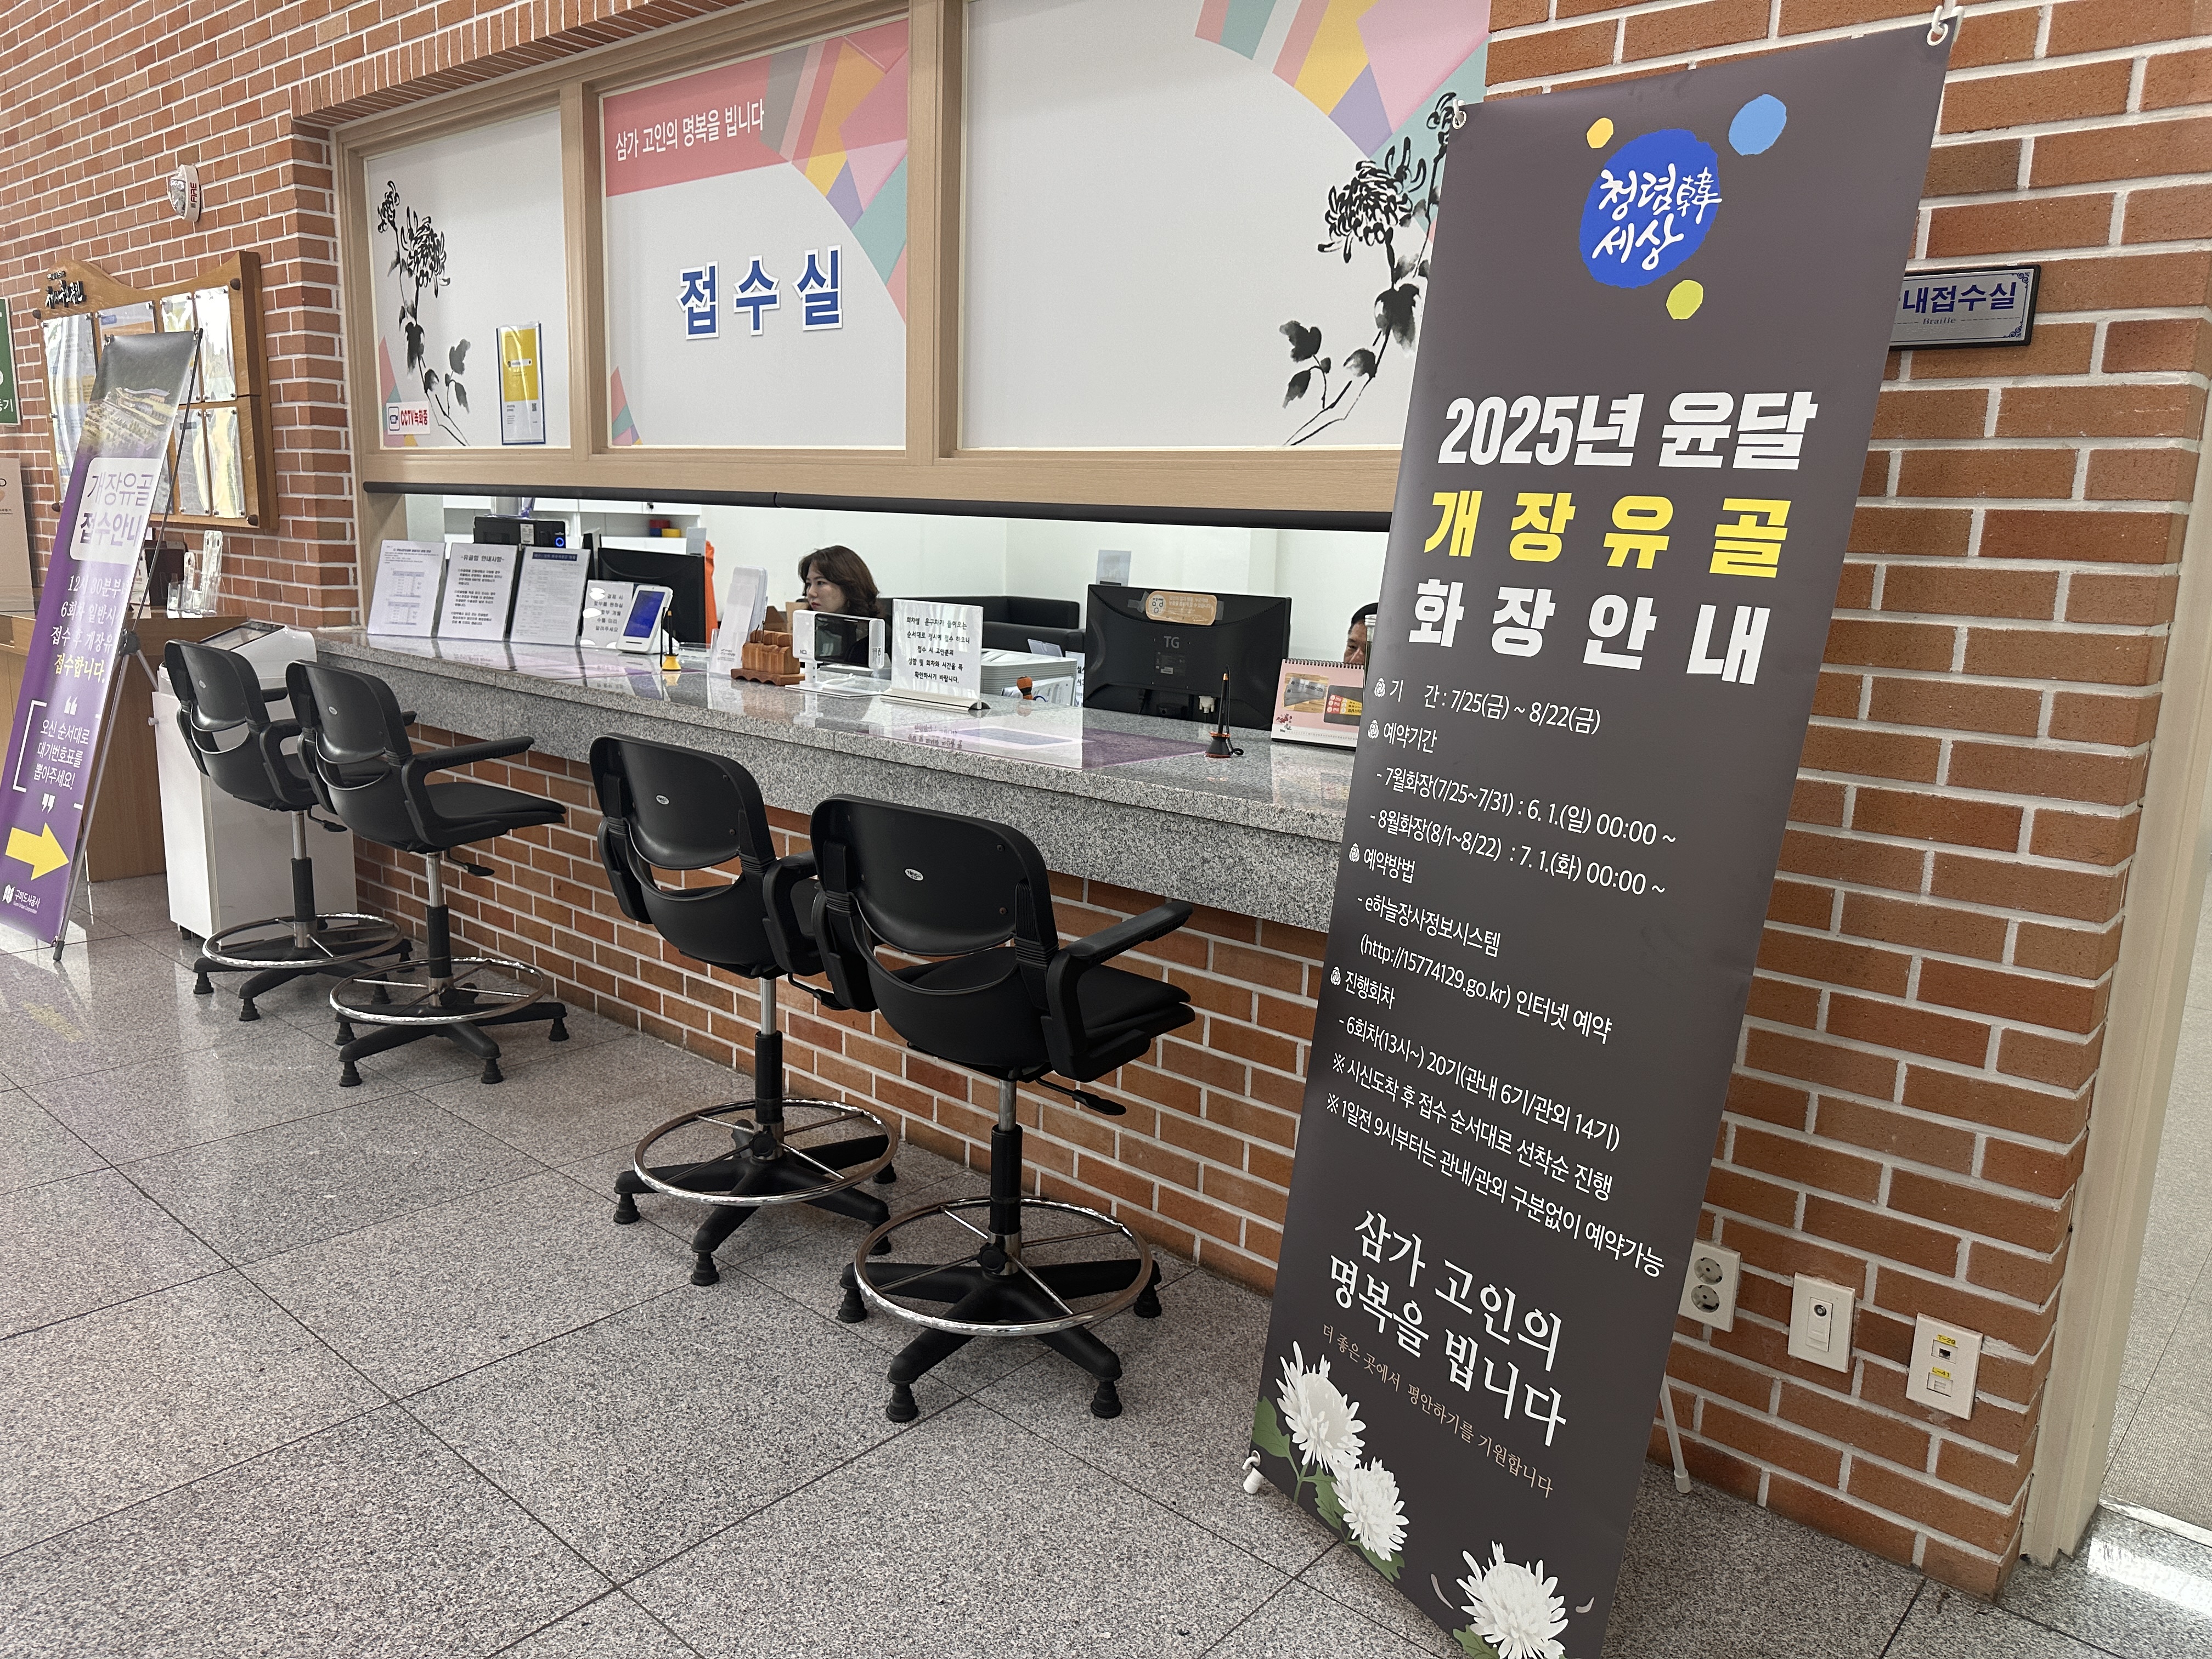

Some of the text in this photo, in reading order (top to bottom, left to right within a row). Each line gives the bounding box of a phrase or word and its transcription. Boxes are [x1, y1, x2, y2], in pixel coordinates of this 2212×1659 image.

[615, 98, 765, 161] 삼가 고인의 명복을 빕니다
[1592, 213, 1684, 270] 세상
[1899, 282, 2017, 313] 내접수실
[400, 409, 427, 426] CCTV녹화중
[1438, 392, 1818, 470] 2025년 윤달
[87, 472, 154, 506] 개장유골
[80, 512, 144, 546] 접수안내
[68, 575, 88, 595] 12시
[61, 601, 85, 622] 6회차
[906, 617, 967, 630] 회차별 운구차가 들어오는
[50, 625, 71, 647] 접수
[74, 628, 83, 649] 후
[935, 648, 953, 656] 고인분의
[1164, 635, 1180, 649] TG
[54, 653, 105, 684] 접수합니다.
[915, 671, 936, 680] 확인하시기
[942, 662, 956, 670] 시간을
[1451, 690, 1509, 720] 7/25(금)
[1529, 702, 1601, 735] 8/22(금)
[40, 719, 90, 744] 오신 순서대로
[1383, 723, 1437, 753] 예약기간
[37, 742, 83, 768] 대기번호표를
[34, 763, 76, 790] 뽑아주세요!
[1596, 814, 1656, 845] 00:00
[1364, 848, 1415, 883] 예약방법
[1587, 862, 1646, 895] 00:00
[15, 889, 41, 909] 구미도시공사
[1365, 895, 1501, 957] e하늘장사정보시스템
[1345, 971, 1395, 1009] 진행회차
[1360, 934, 1612, 1044] (http://15774129.go.kr) 인터넷 예약
[1346, 1016, 1424, 1068] 6회차(13시~)
[1427, 1052, 1496, 1101] 20기(관내
[1500, 1084, 1570, 1131] 6기/관외
[1575, 1114, 1620, 1151] 14기)
[1347, 1059, 1399, 1102] 시신도착
[1401, 1085, 1414, 1109] 후
[1418, 1093, 1447, 1124] 접수
[1450, 1108, 1511, 1155] 순서대로
[1516, 1139, 1569, 1183] 선착순
[1574, 1164, 1612, 1201] 진행
[1342, 1100, 1373, 1134] 1일전
[1374, 1117, 1437, 1167] 9시부터는
[1440, 1149, 1508, 1204] 관내/관외
[1510, 1185, 1581, 1240] 구분없이
[1585, 1221, 1664, 1277] 예약가능
[1355, 1210, 1562, 1372] 삼가 고인의
[1331, 1255, 1566, 1447] 명복을 빕니다
[1938, 1334, 1956, 1345] T-29
[1932, 1367, 1949, 1377] L-41
[1323, 1324, 1553, 1498] 더 좋은 곳에서 평안하기를 기원합니다
